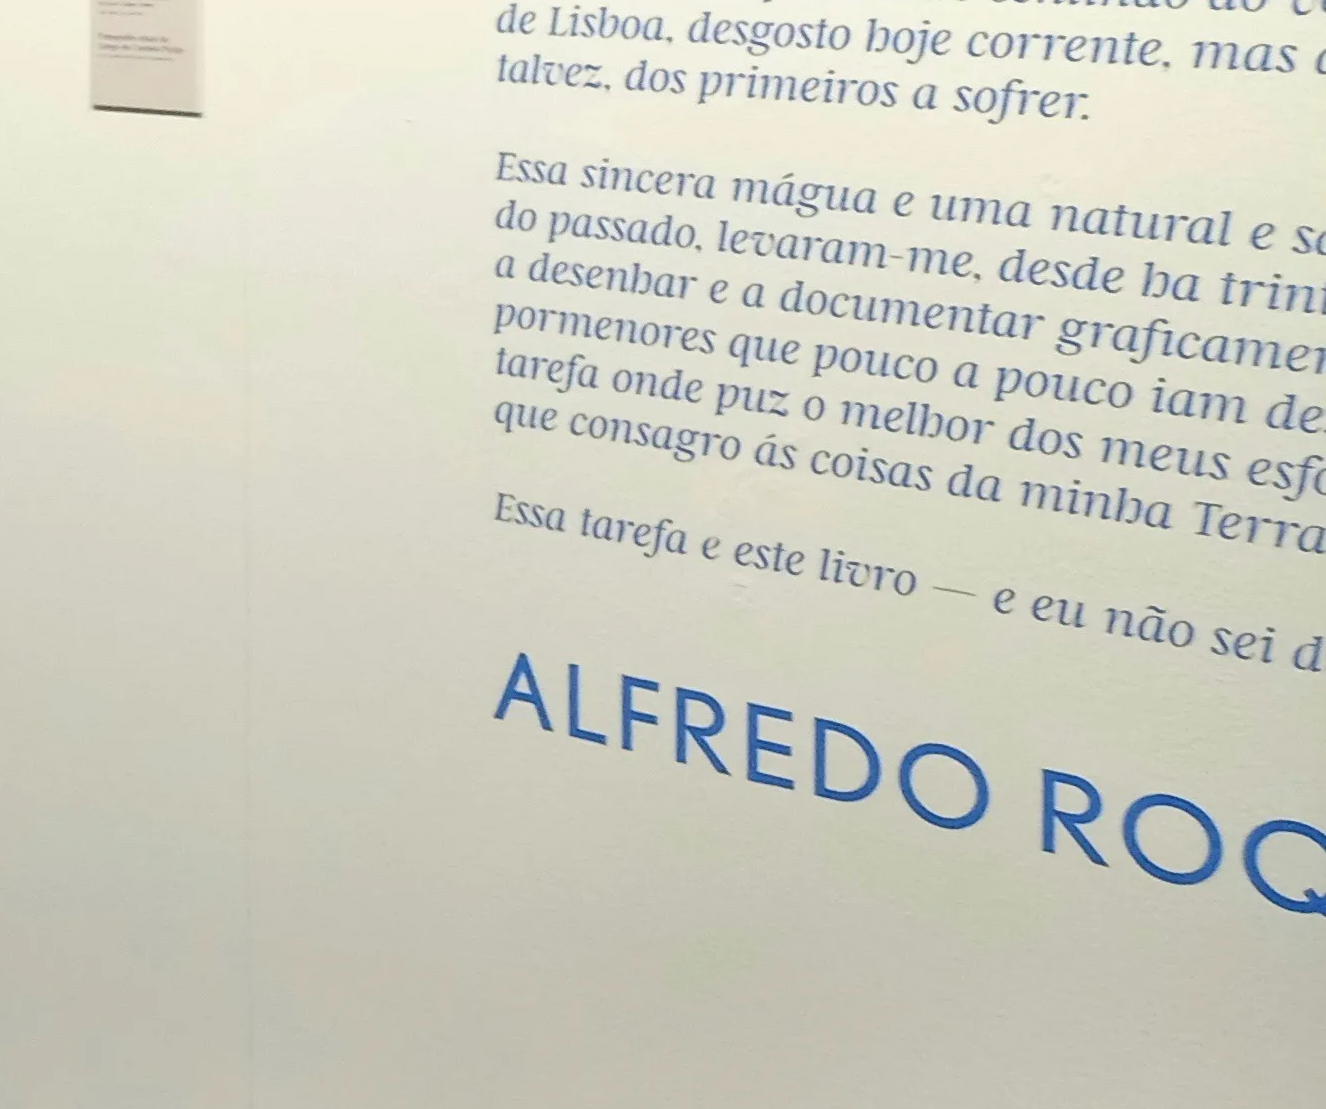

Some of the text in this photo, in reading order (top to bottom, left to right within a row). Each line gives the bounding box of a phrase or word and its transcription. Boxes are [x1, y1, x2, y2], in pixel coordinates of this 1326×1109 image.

[496, 3, 536, 35] de
[687, 11, 852, 56] desgosto
[865, 18, 952, 65] hoje
[1192, 41, 1298, 73] mas
[624, 59, 687, 94] dos
[697, 65, 899, 108] primeiros
[912, 84, 938, 110] a
[494, 199, 537, 232] do
[998, 249, 1125, 294] desde
[1141, 261, 1200, 302] ha
[495, 151, 567, 186] Essa
[580, 158, 715, 199] sincera
[732, 172, 877, 218] mágua
[892, 191, 915, 217] e
[931, 194, 1031, 228] uma
[1051, 204, 1233, 247] natural
[1249, 223, 1276, 250] e
[494, 255, 515, 279] a
[528, 252, 698, 299] desenhar
[708, 279, 729, 304] e
[741, 283, 764, 309] a
[779, 280, 1045, 340] documentar
[493, 303, 1326, 434] pormenores que pouco a pouco iam de
[496, 347, 598, 394] tarefa
[612, 369, 703, 403] onde
[715, 383, 789, 417] puz
[803, 396, 826, 421] o
[841, 400, 995, 445] melhor
[1008, 418, 1083, 459] dos
[1101, 437, 1231, 480] meus
[494, 401, 1326, 554] que consagro ás coisas da minha Terra
[494, 492, 565, 532] Essa
[580, 508, 687, 558] tarefa
[701, 537, 721, 560] e
[733, 542, 805, 576] este
[819, 548, 917, 596] livro
[993, 588, 1016, 614] e
[1031, 595, 1085, 628] eu
[1105, 605, 1196, 647] não
[1210, 627, 1276, 664] sei
[493, 652, 1326, 917] ALFREDO ROQ
